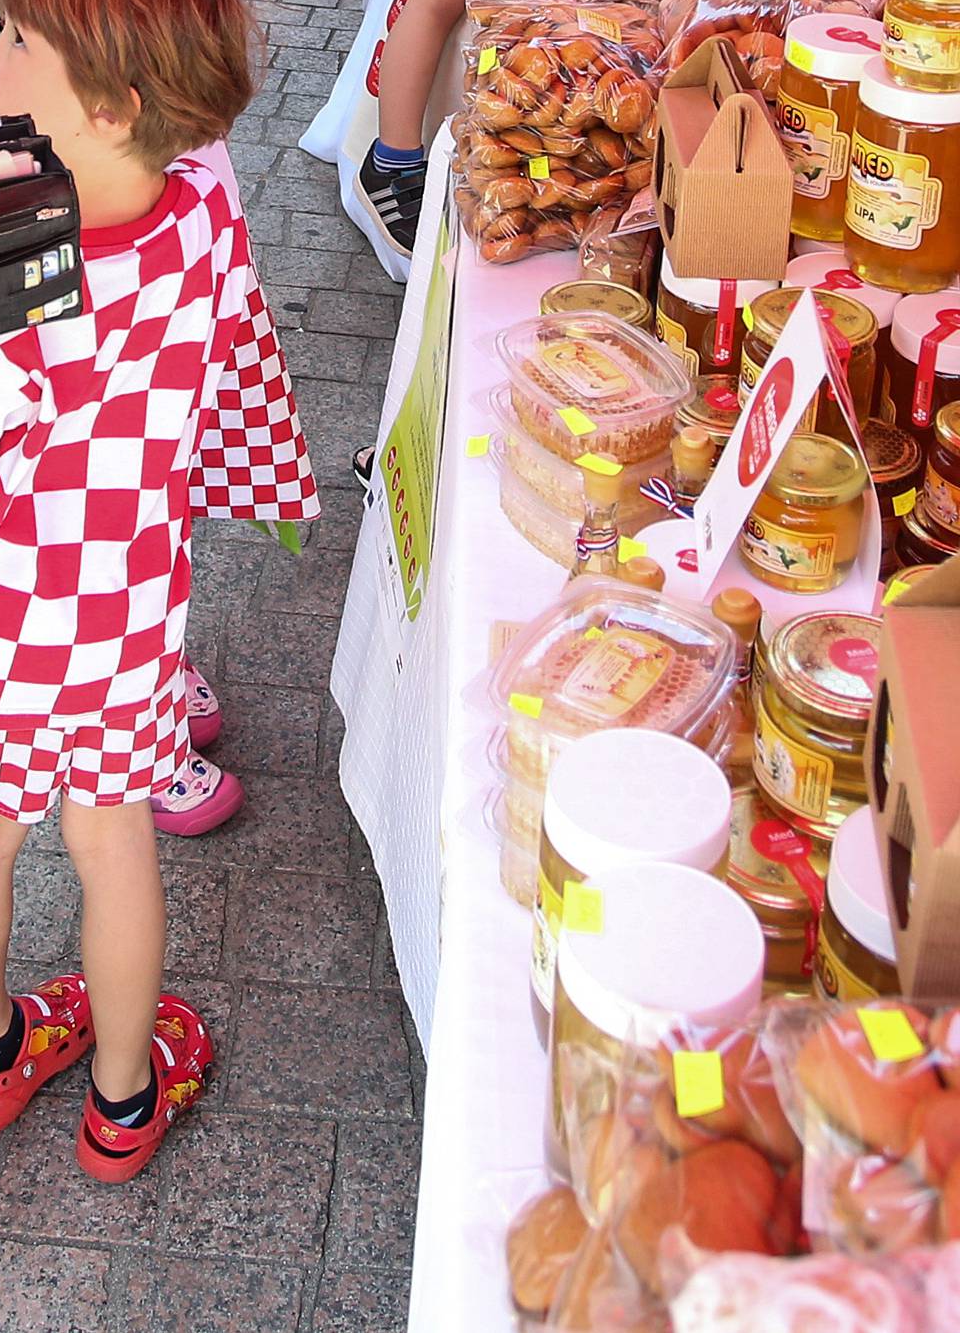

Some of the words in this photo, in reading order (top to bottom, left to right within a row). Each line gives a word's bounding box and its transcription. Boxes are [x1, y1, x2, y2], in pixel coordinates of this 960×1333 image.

[779, 104, 806, 134] ED
[851, 142, 894, 181] MED
[854, 203, 876, 223] LIPA
[767, 829, 796, 842] Med
